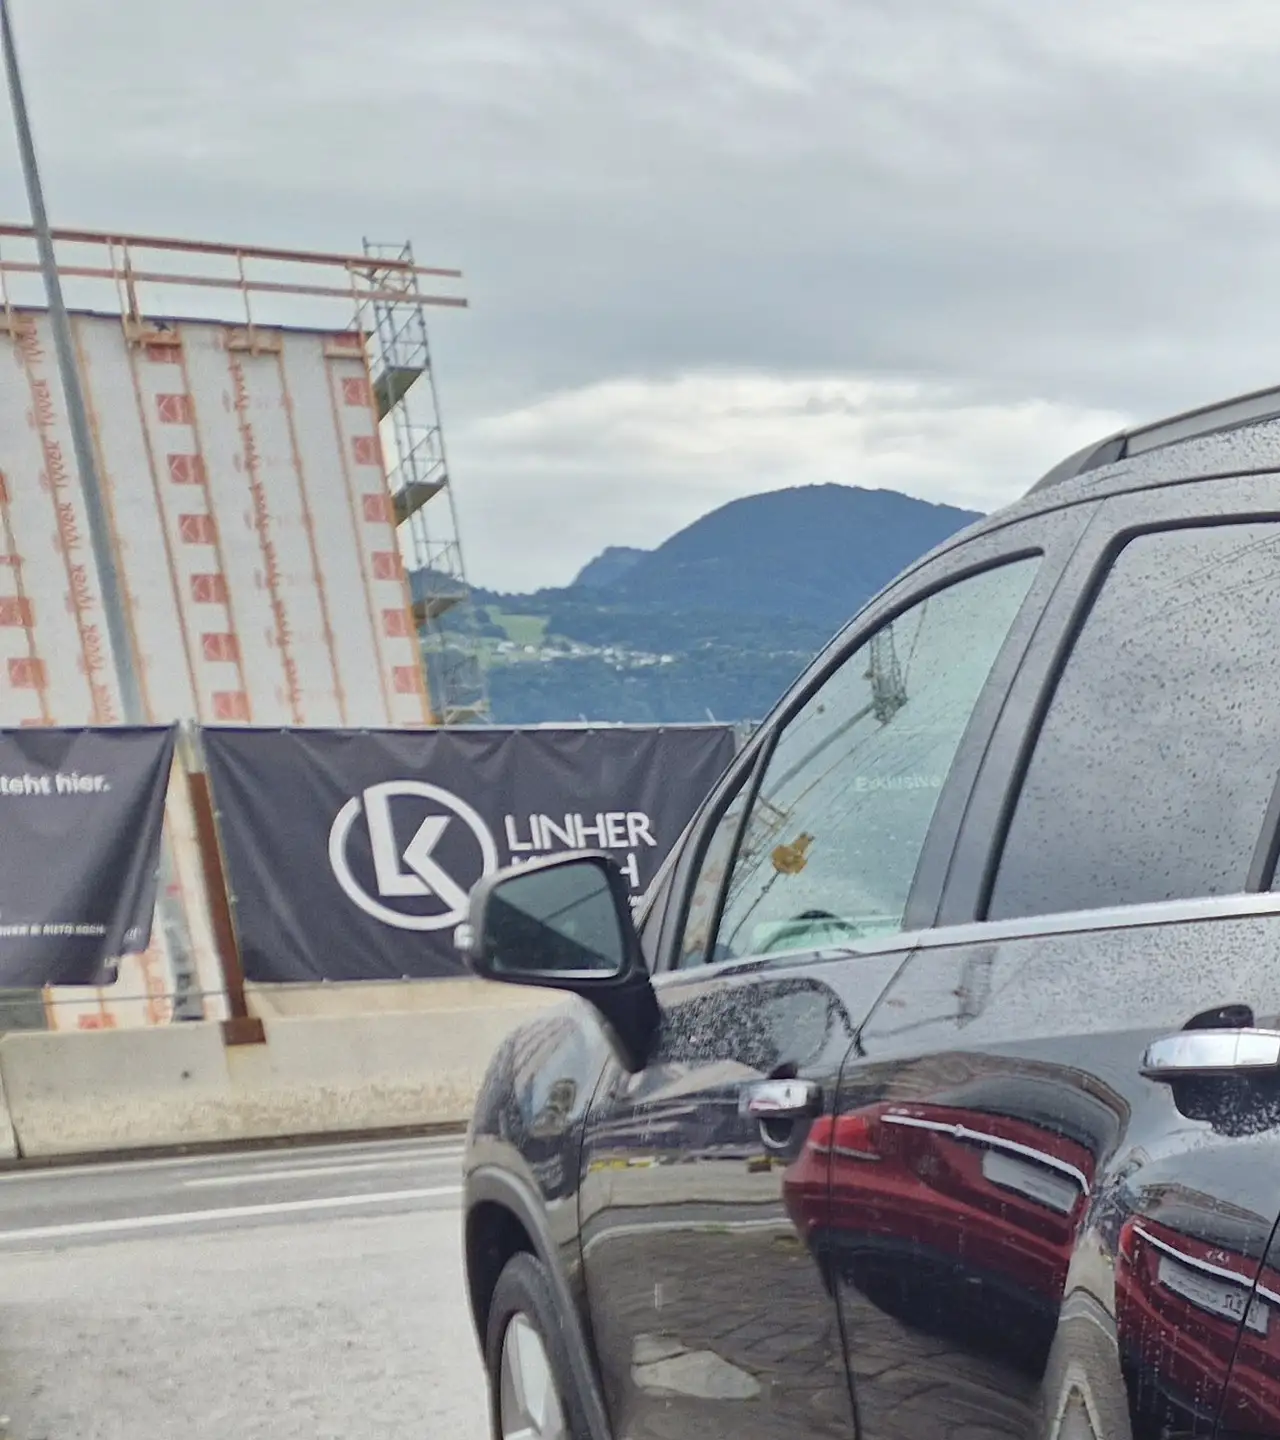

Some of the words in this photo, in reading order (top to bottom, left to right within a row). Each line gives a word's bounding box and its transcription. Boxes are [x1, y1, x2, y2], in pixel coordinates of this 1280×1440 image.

[32, 379, 57, 426] Tyvek
[44, 440, 70, 488] Tyvek
[58, 502, 79, 549] Tyvek
[72, 564, 95, 609] Tyvek
[505, 812, 657, 850] LINHER
